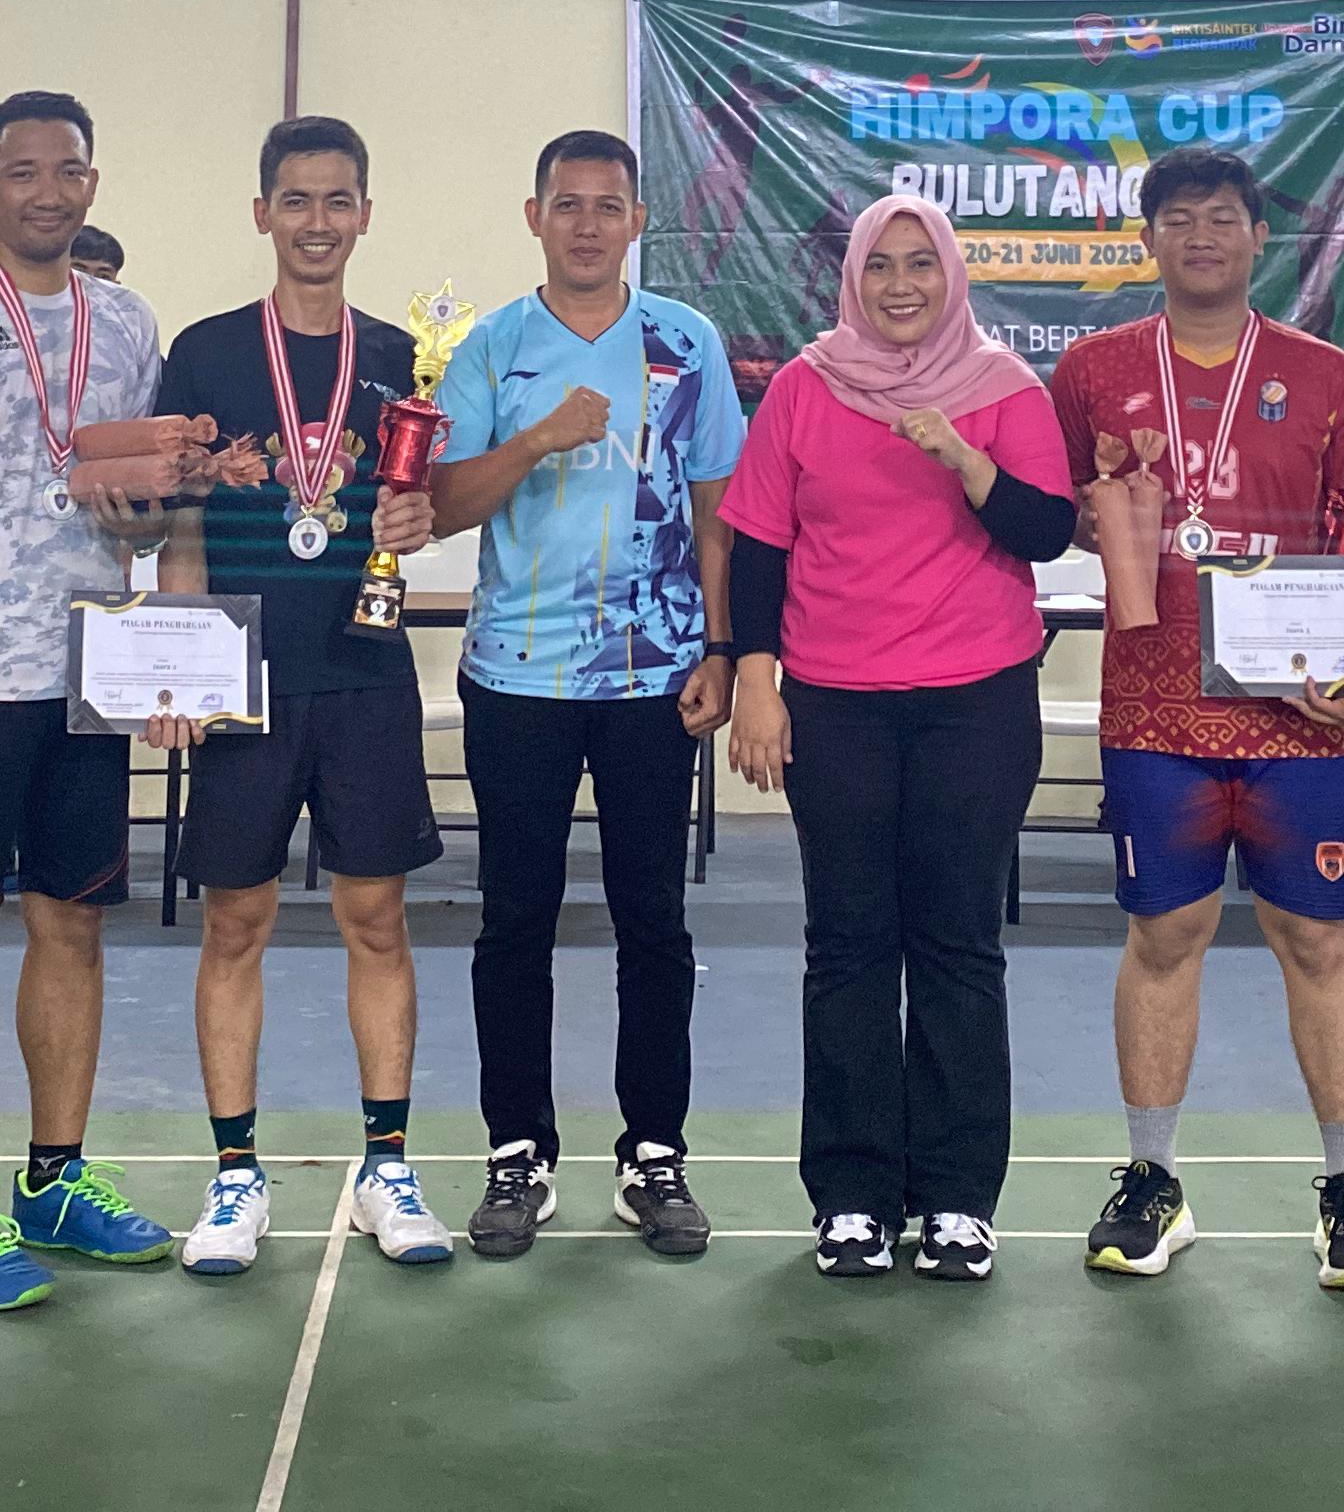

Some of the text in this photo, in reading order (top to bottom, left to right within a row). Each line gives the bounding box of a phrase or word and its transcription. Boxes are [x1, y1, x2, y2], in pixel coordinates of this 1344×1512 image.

[850, 92, 1285, 143] HIMPORA CUP
[964, 242, 1144, 266] 20-21 JUNI 2025
[369, 598, 386, 625] 2
